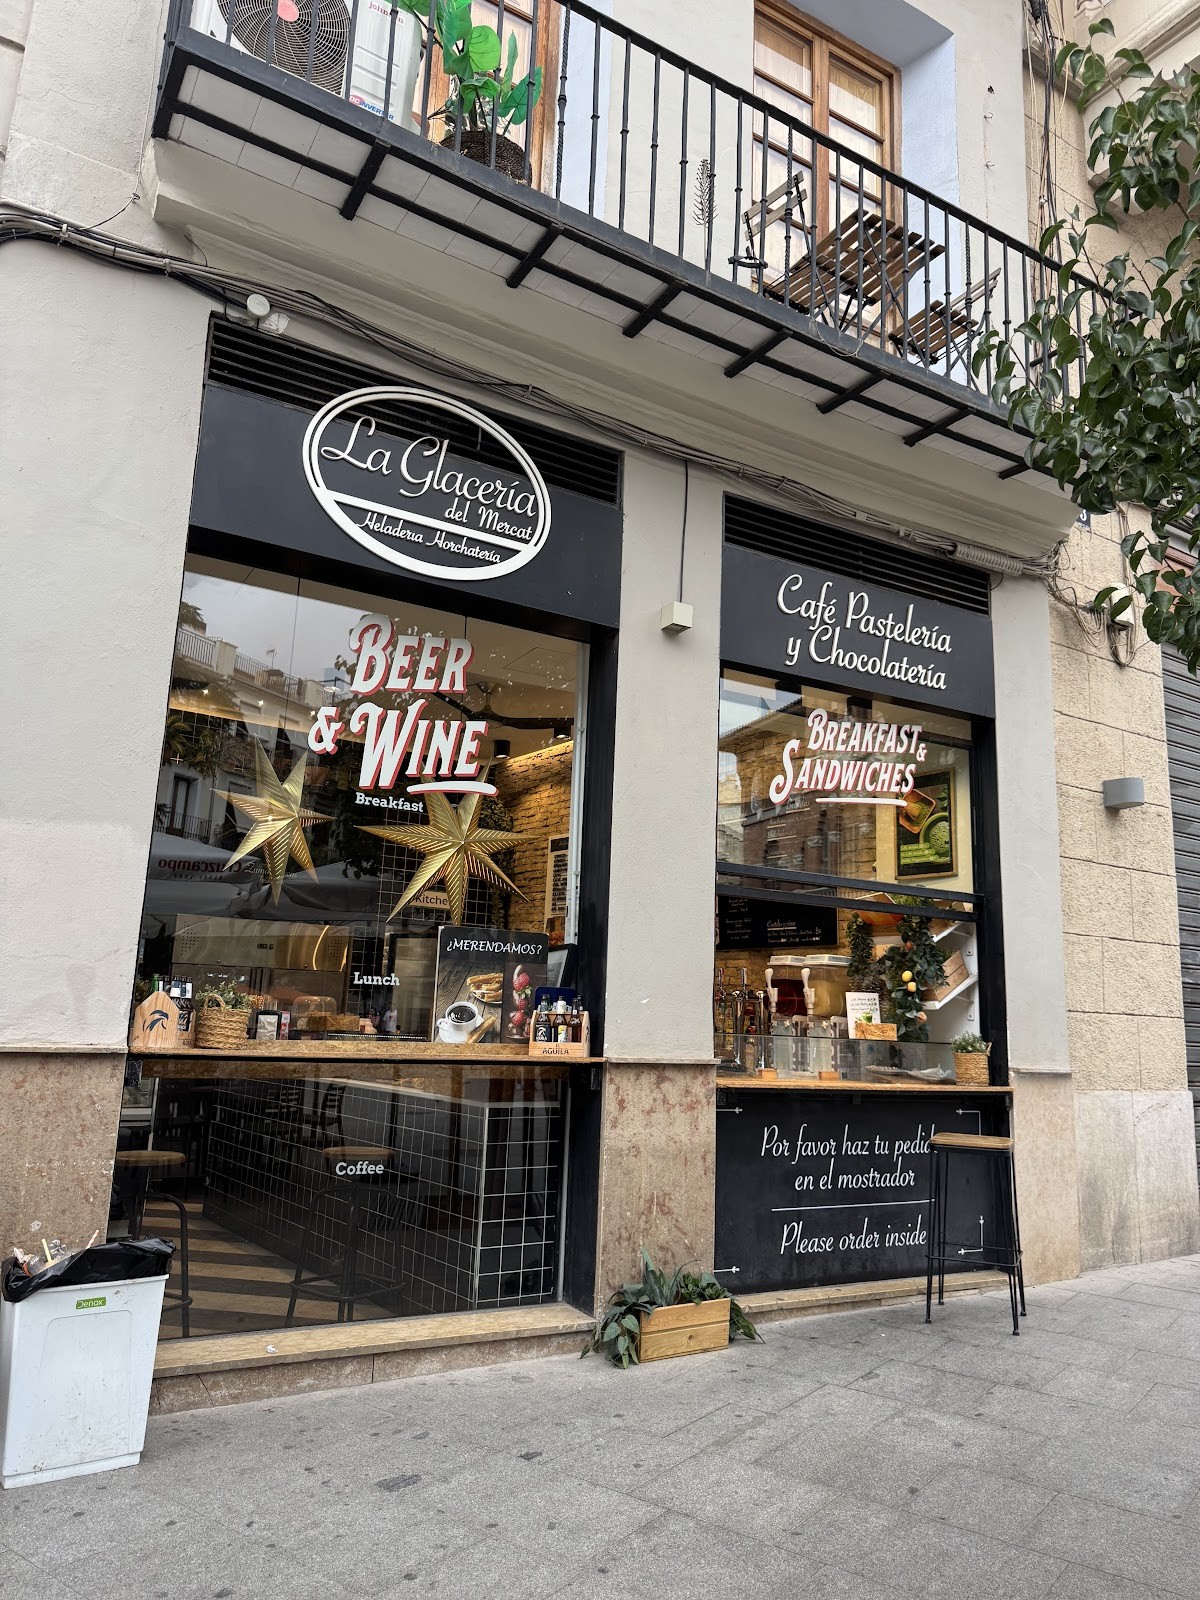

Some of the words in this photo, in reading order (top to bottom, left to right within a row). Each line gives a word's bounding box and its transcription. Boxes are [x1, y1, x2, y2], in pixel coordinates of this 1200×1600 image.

[369, 2, 404, 24] johnn
[360, 101, 395, 120] INVERTR
[321, 416, 392, 475] La
[399, 436, 536, 517] Glacería
[445, 498, 470, 523] del
[478, 506, 532, 540] Mercat
[426, 531, 500, 563] Horchatería
[777, 574, 837, 631] Café
[845, 591, 952, 653] Pastelería
[350, 613, 474, 696] BEER
[785, 637, 801, 666] y
[808, 625, 947, 690] Chocolatería
[308, 706, 345, 755] &
[350, 699, 489, 790] WINE
[807, 708, 923, 754] BREAKFAST
[916, 743, 928, 762] &
[769, 739, 917, 805] SANDWICHES
[355, 792, 424, 812] Breakfast
[415, 894, 448, 905] Kitche
[446, 938, 542, 955] ¿MERENDAMOS?
[353, 971, 400, 986] Lunch
[761, 1125, 789, 1156] Por
[791, 1124, 836, 1165] favor
[842, 1124, 869, 1155] haz
[875, 1134, 889, 1155] tu
[894, 1124, 938, 1162] pedid
[335, 1161, 385, 1176] Coffee
[795, 1174, 814, 1190] en
[820, 1158, 834, 1190] el
[838, 1156, 915, 1189] mostrador
[780, 1221, 834, 1255] Please
[839, 1217, 880, 1251] order
[885, 1214, 927, 1247] inside
[77, 1300, 103, 1309] Denox
